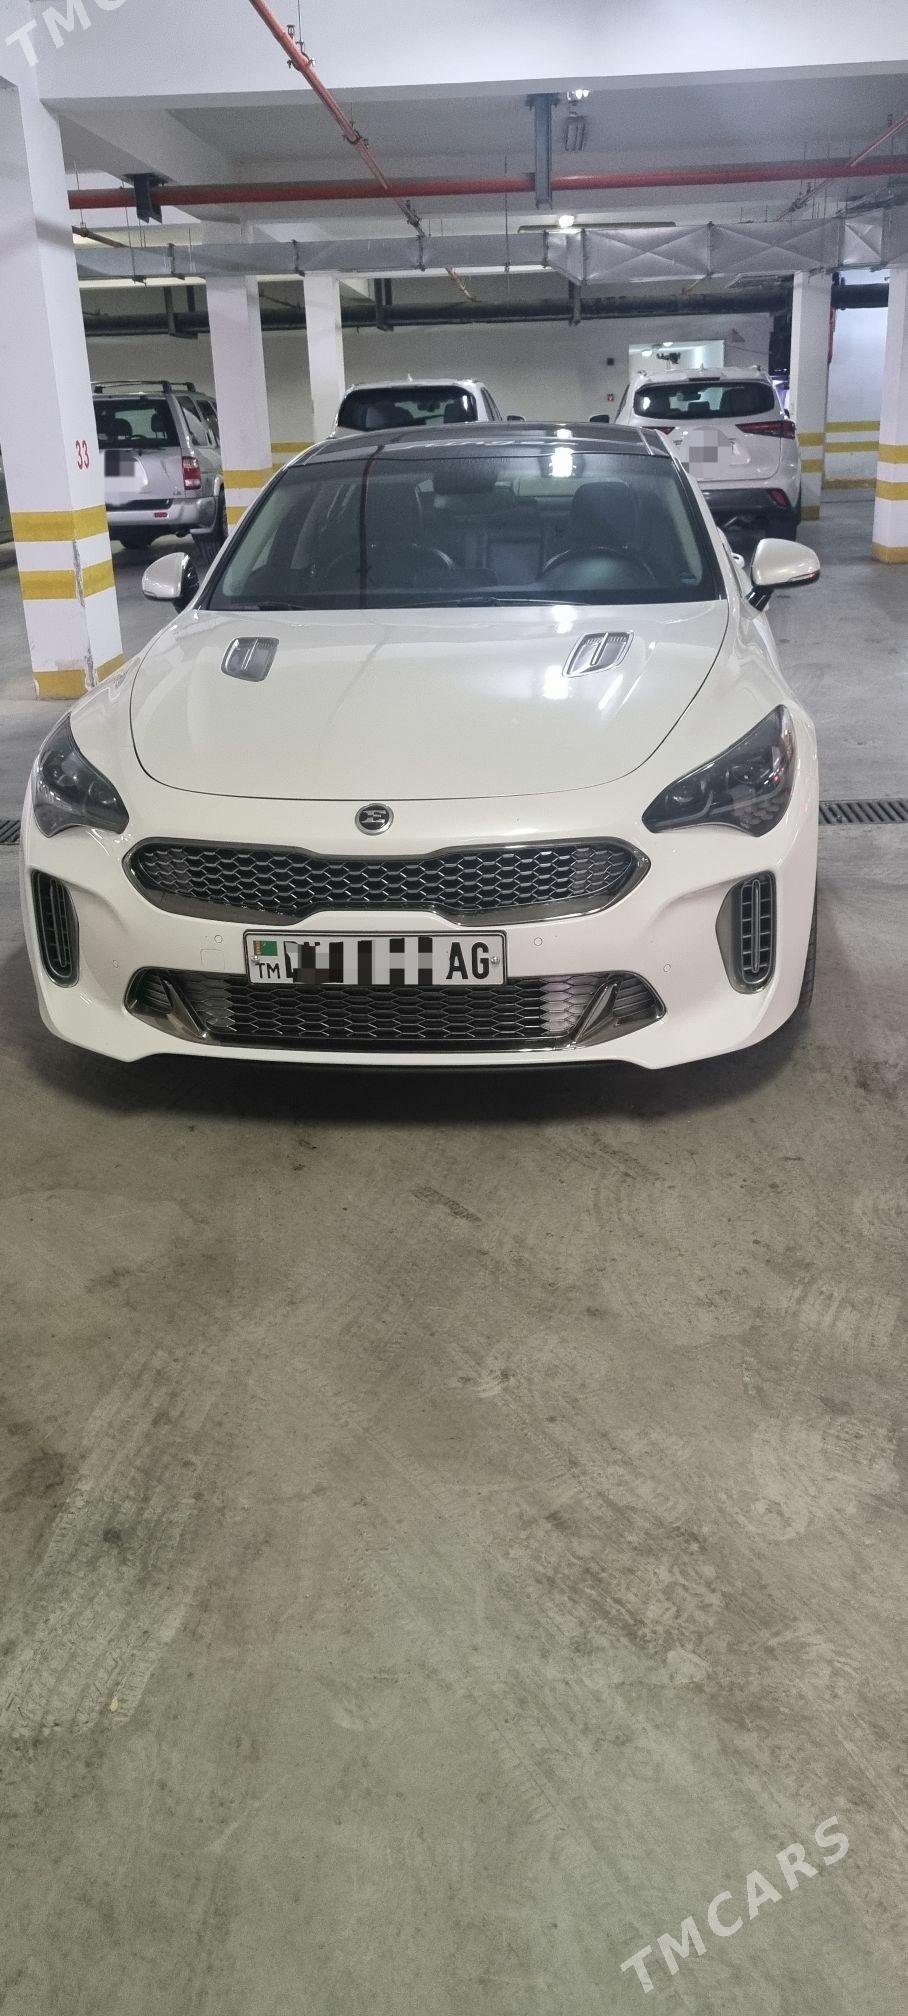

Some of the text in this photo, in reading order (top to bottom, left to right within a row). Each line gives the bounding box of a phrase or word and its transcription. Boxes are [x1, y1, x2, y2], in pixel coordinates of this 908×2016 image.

[75, 439, 90, 470] 33
[255, 962, 281, 979] TM
[446, 941, 490, 980] AG
